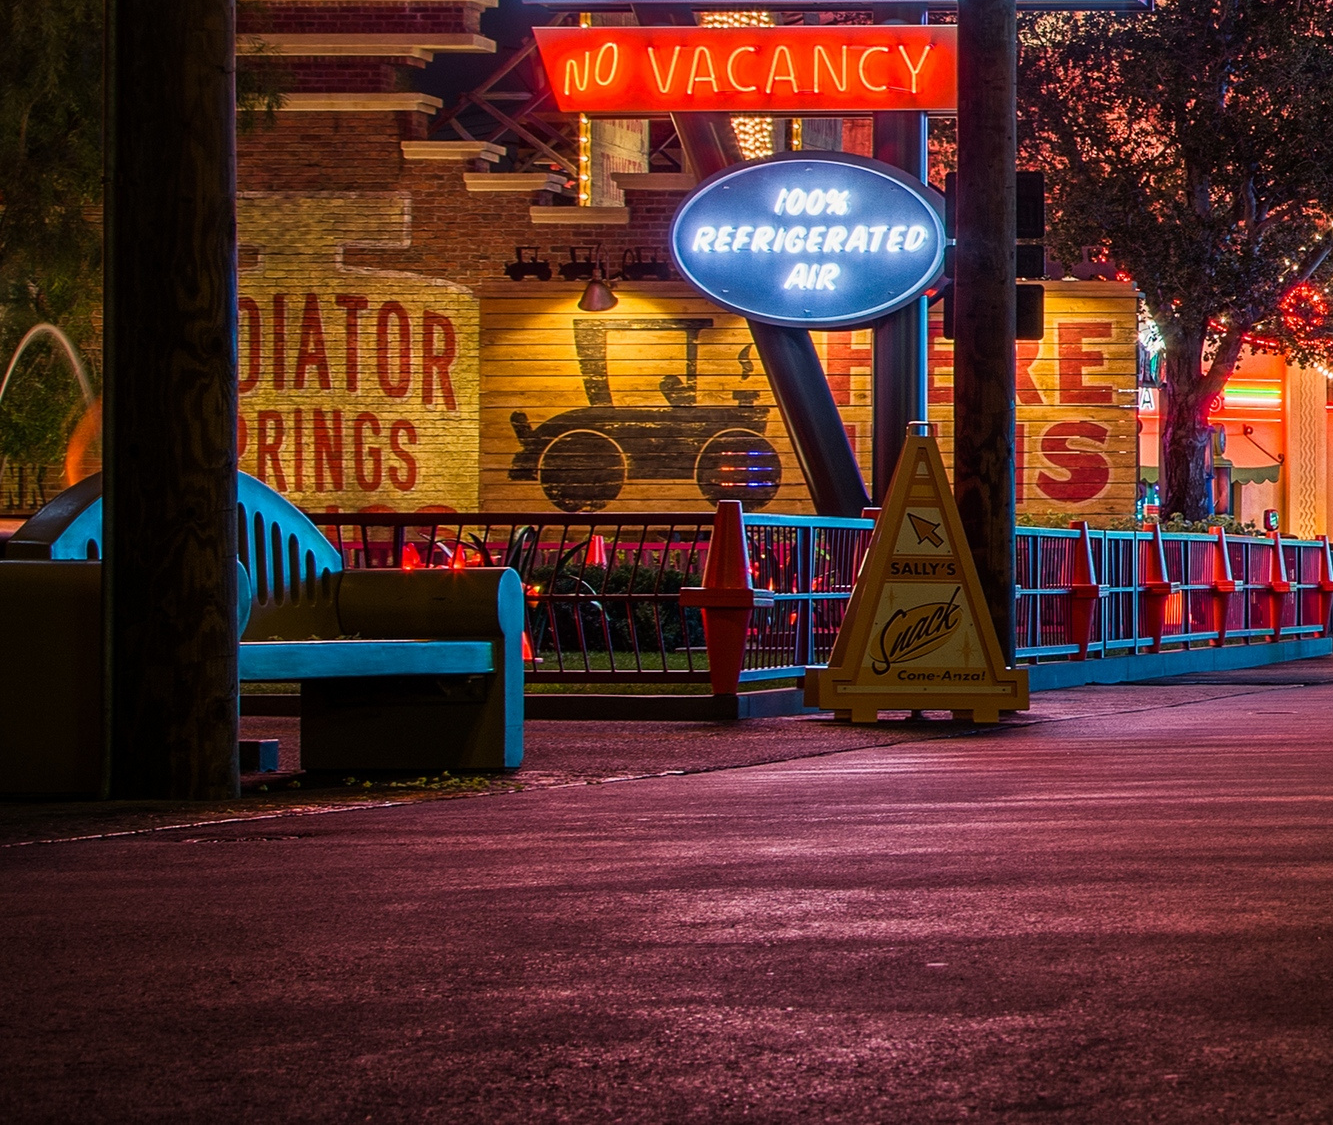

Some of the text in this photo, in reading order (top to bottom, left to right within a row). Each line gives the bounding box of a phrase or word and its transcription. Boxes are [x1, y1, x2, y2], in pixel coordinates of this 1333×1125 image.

[564, 42, 932, 96] NO VACANCY
[774, 187, 850, 215] 100%
[692, 224, 927, 254] REFRIGERATED
[784, 262, 840, 291] AIR
[890, 562, 957, 576] SALLY'S
[872, 586, 961, 675] Snack
[897, 669, 986, 682] Cone-Anza!
